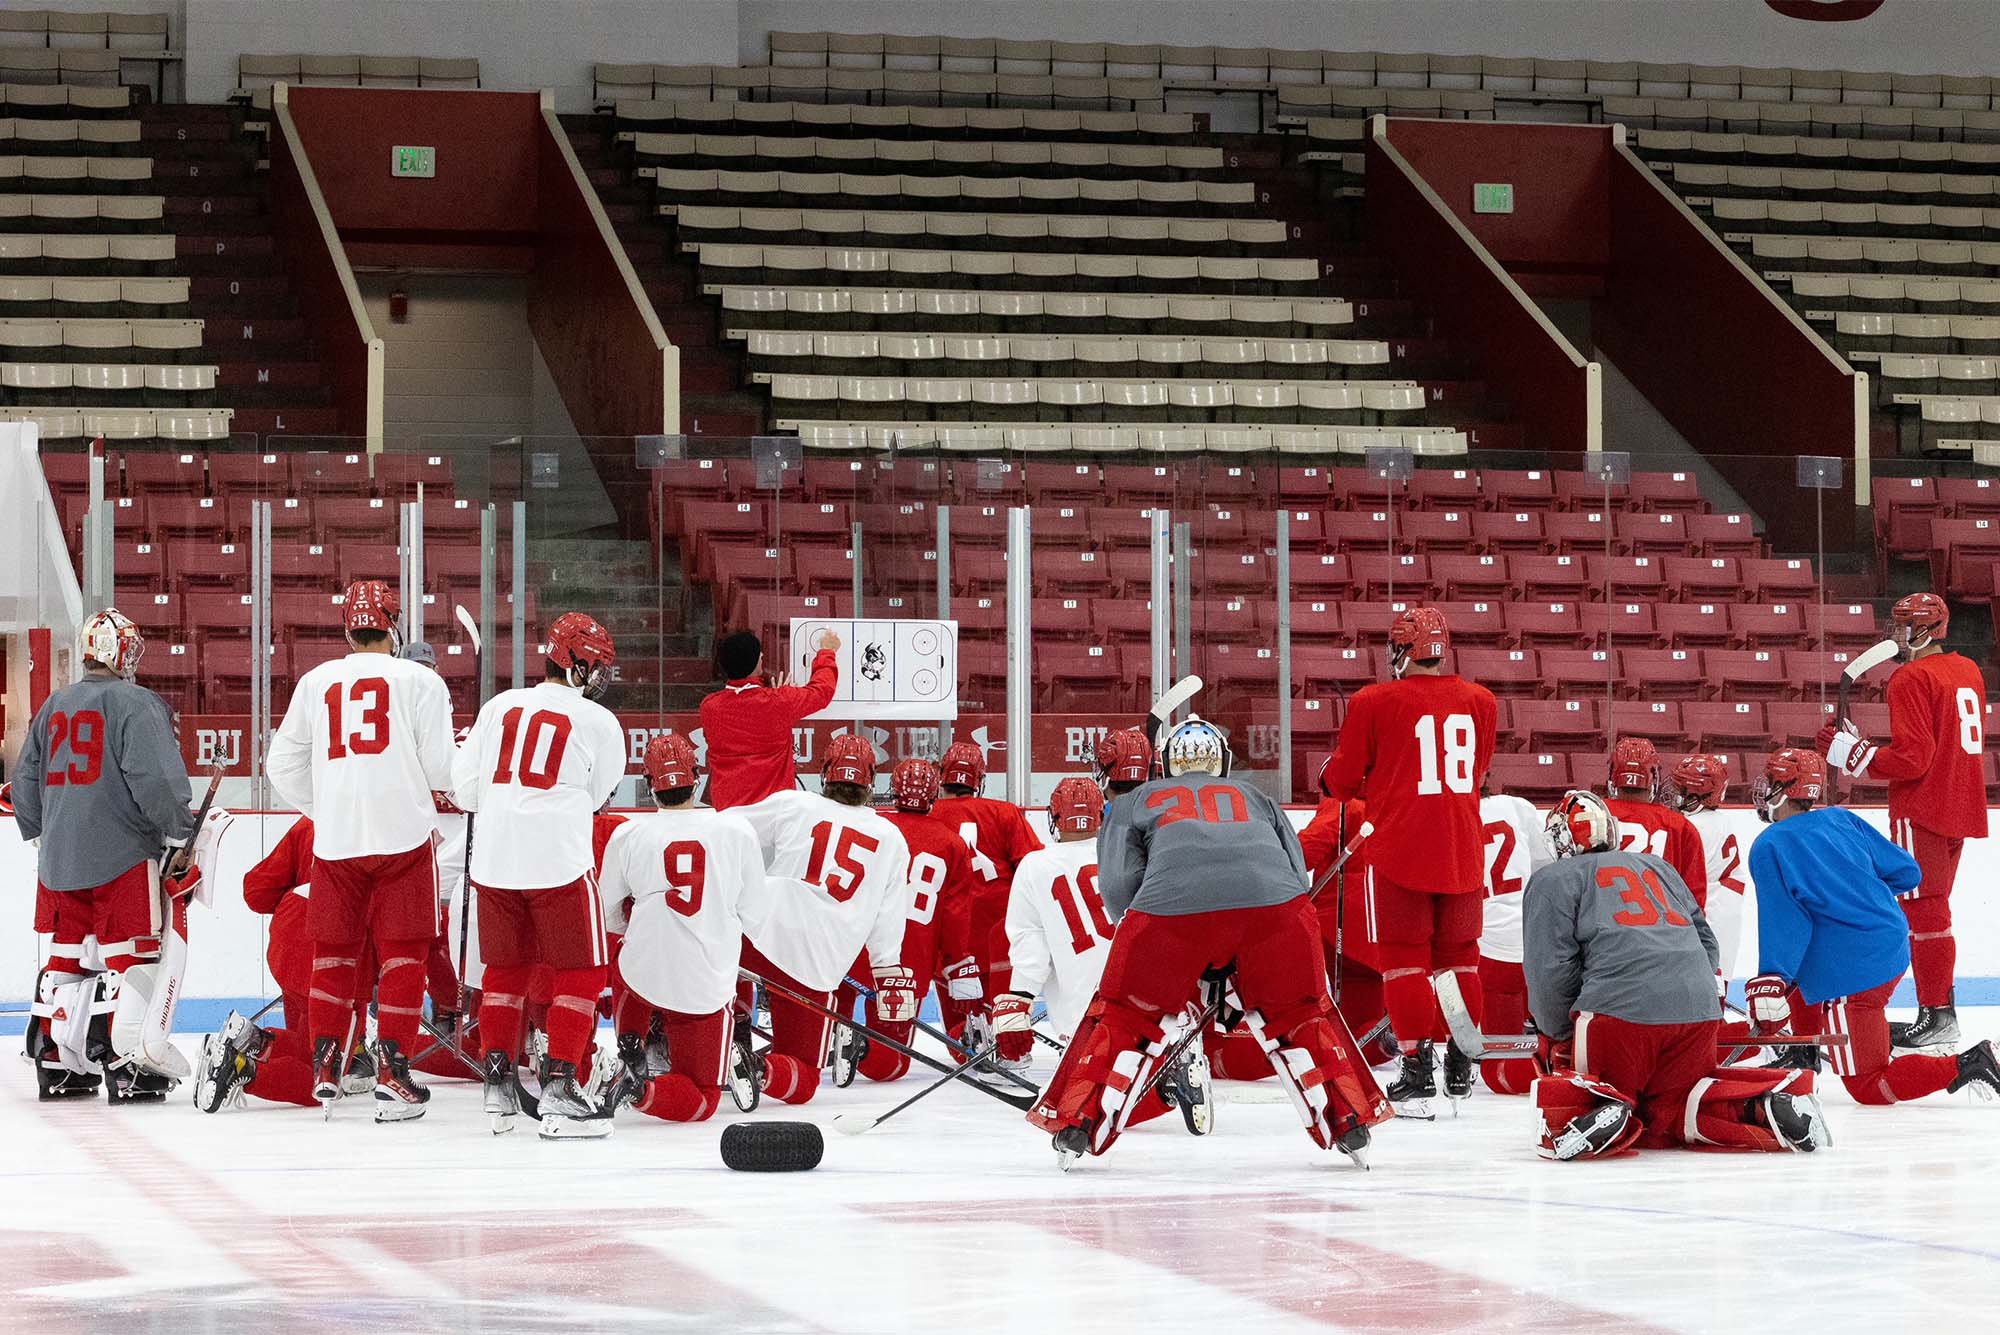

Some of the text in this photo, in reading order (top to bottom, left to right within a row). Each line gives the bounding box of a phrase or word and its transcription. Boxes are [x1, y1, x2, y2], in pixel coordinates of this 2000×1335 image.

[177, 129, 186, 140] S
[1230, 156, 1238, 167] S
[190, 166, 198, 177] R
[1262, 193, 1270, 204] R
[203, 201, 211, 213] Q
[217, 243, 225, 255] P
[1326, 264, 1334, 276] P
[244, 326, 253, 339] N
[1397, 345, 1405, 357] N
[258, 369, 269, 382] M
[1433, 388, 1443, 401] M
[276, 416, 285, 429] L
[694, 419, 702, 432] L
[1472, 430, 1480, 442] L
[358, 614, 369, 625] 13
[1431, 644, 1441, 655] 18
[325, 677, 390, 760] 13
[1956, 687, 1983, 755] 8
[47, 709, 105, 786] 29
[196, 729, 242, 766] BU
[492, 707, 573, 790] 10
[791, 727, 815, 763] U
[1414, 714, 1475, 795] 18
[668, 775, 677, 785] 9
[844, 769, 855, 780] 15
[956, 772, 966, 783] 14
[1626, 774, 1637, 785] 21
[1808, 786, 1819, 797] 32
[907, 798, 920, 807] 28
[1076, 818, 1087, 829] 16
[801, 820, 880, 903] 15
[1482, 820, 1523, 900] 2
[663, 840, 706, 917] 9
[907, 852, 947, 926] 8
[1596, 865, 1690, 926] 31
[386, 1079, 419, 1104] CCM
